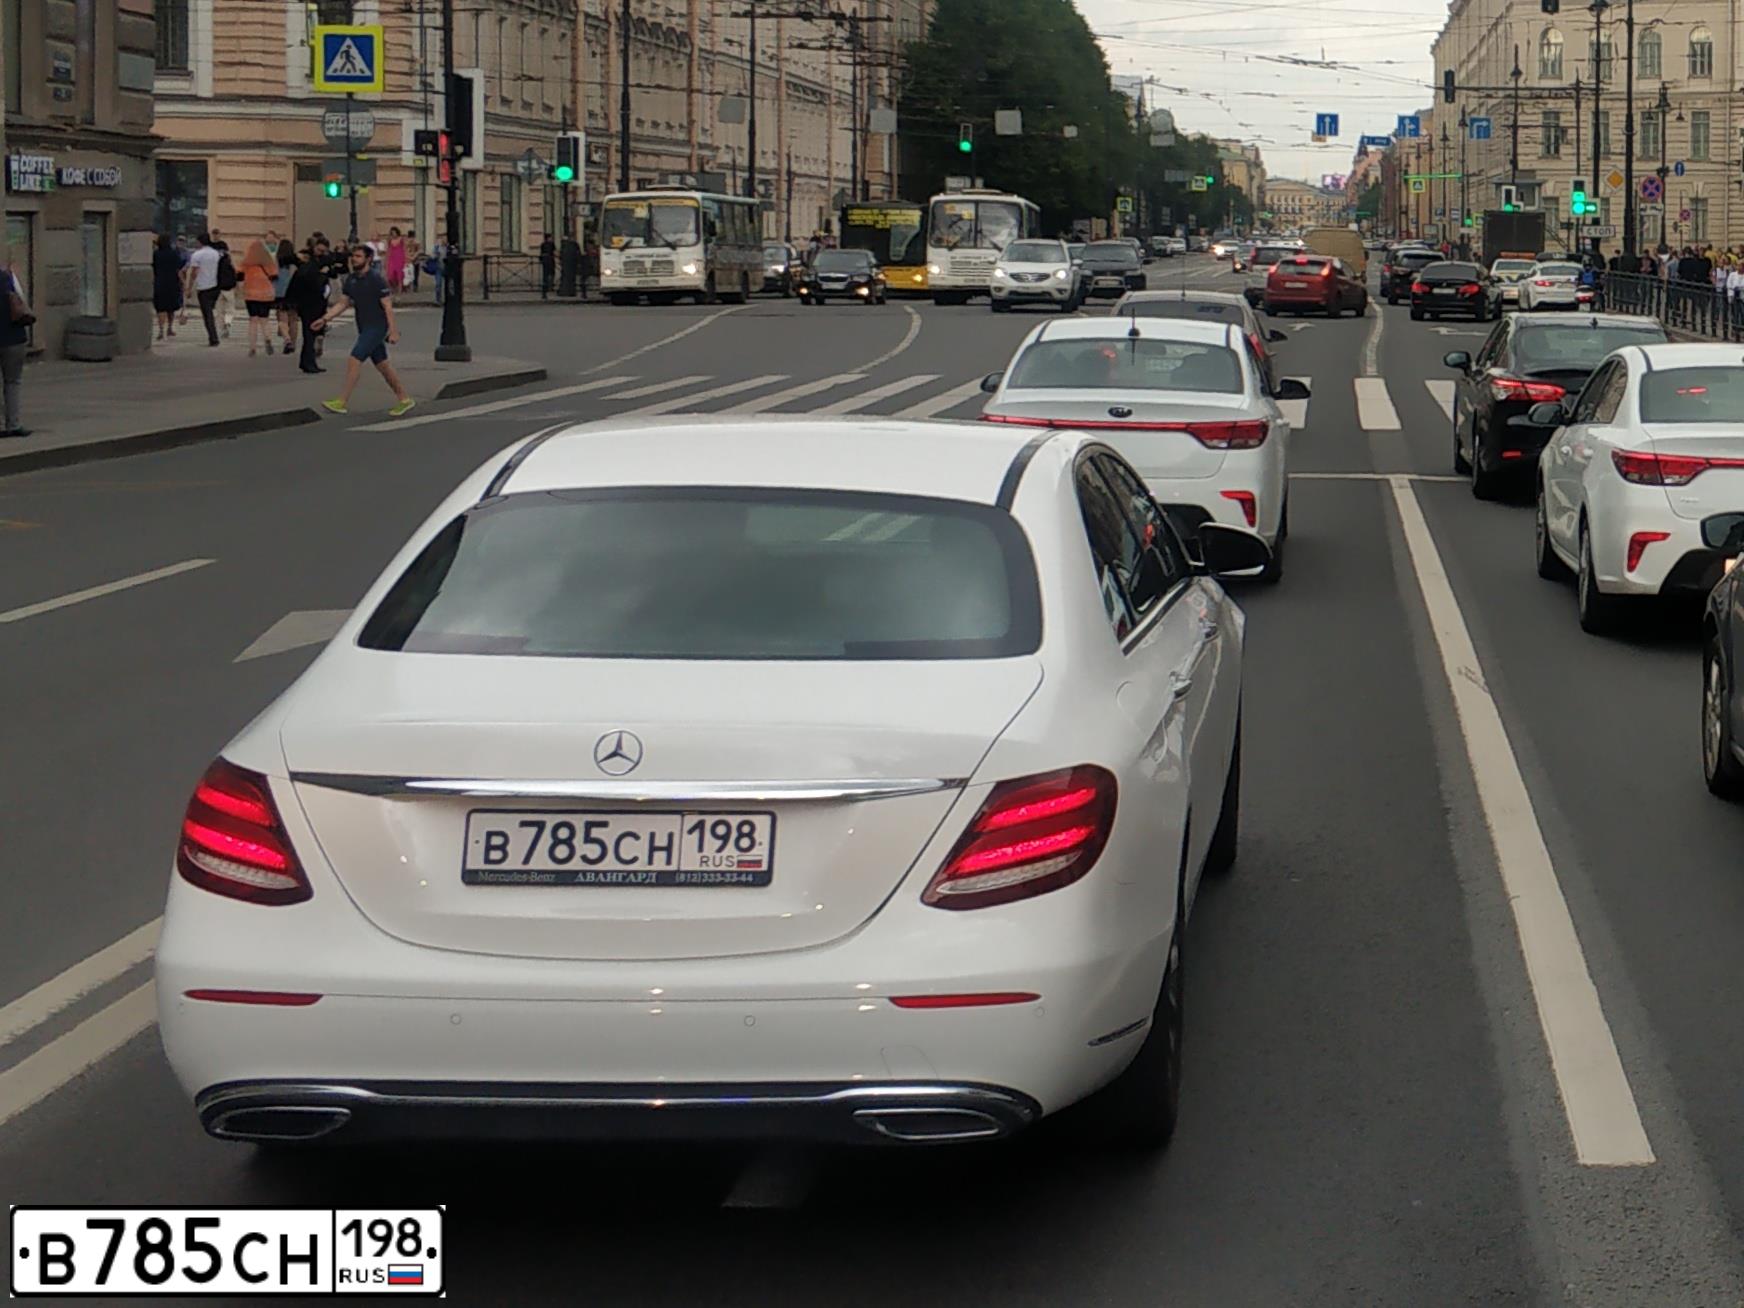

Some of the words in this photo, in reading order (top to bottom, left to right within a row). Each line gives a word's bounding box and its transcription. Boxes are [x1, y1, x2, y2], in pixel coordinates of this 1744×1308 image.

[20, 155, 55, 174] COFFEE
[483, 820, 674, 866] В785СН
[687, 819, 756, 853] 198
[700, 855, 735, 867] RUS
[478, 871, 556, 882] Mercedes-Benz
[574, 872, 657, 884] АВАНГАРД
